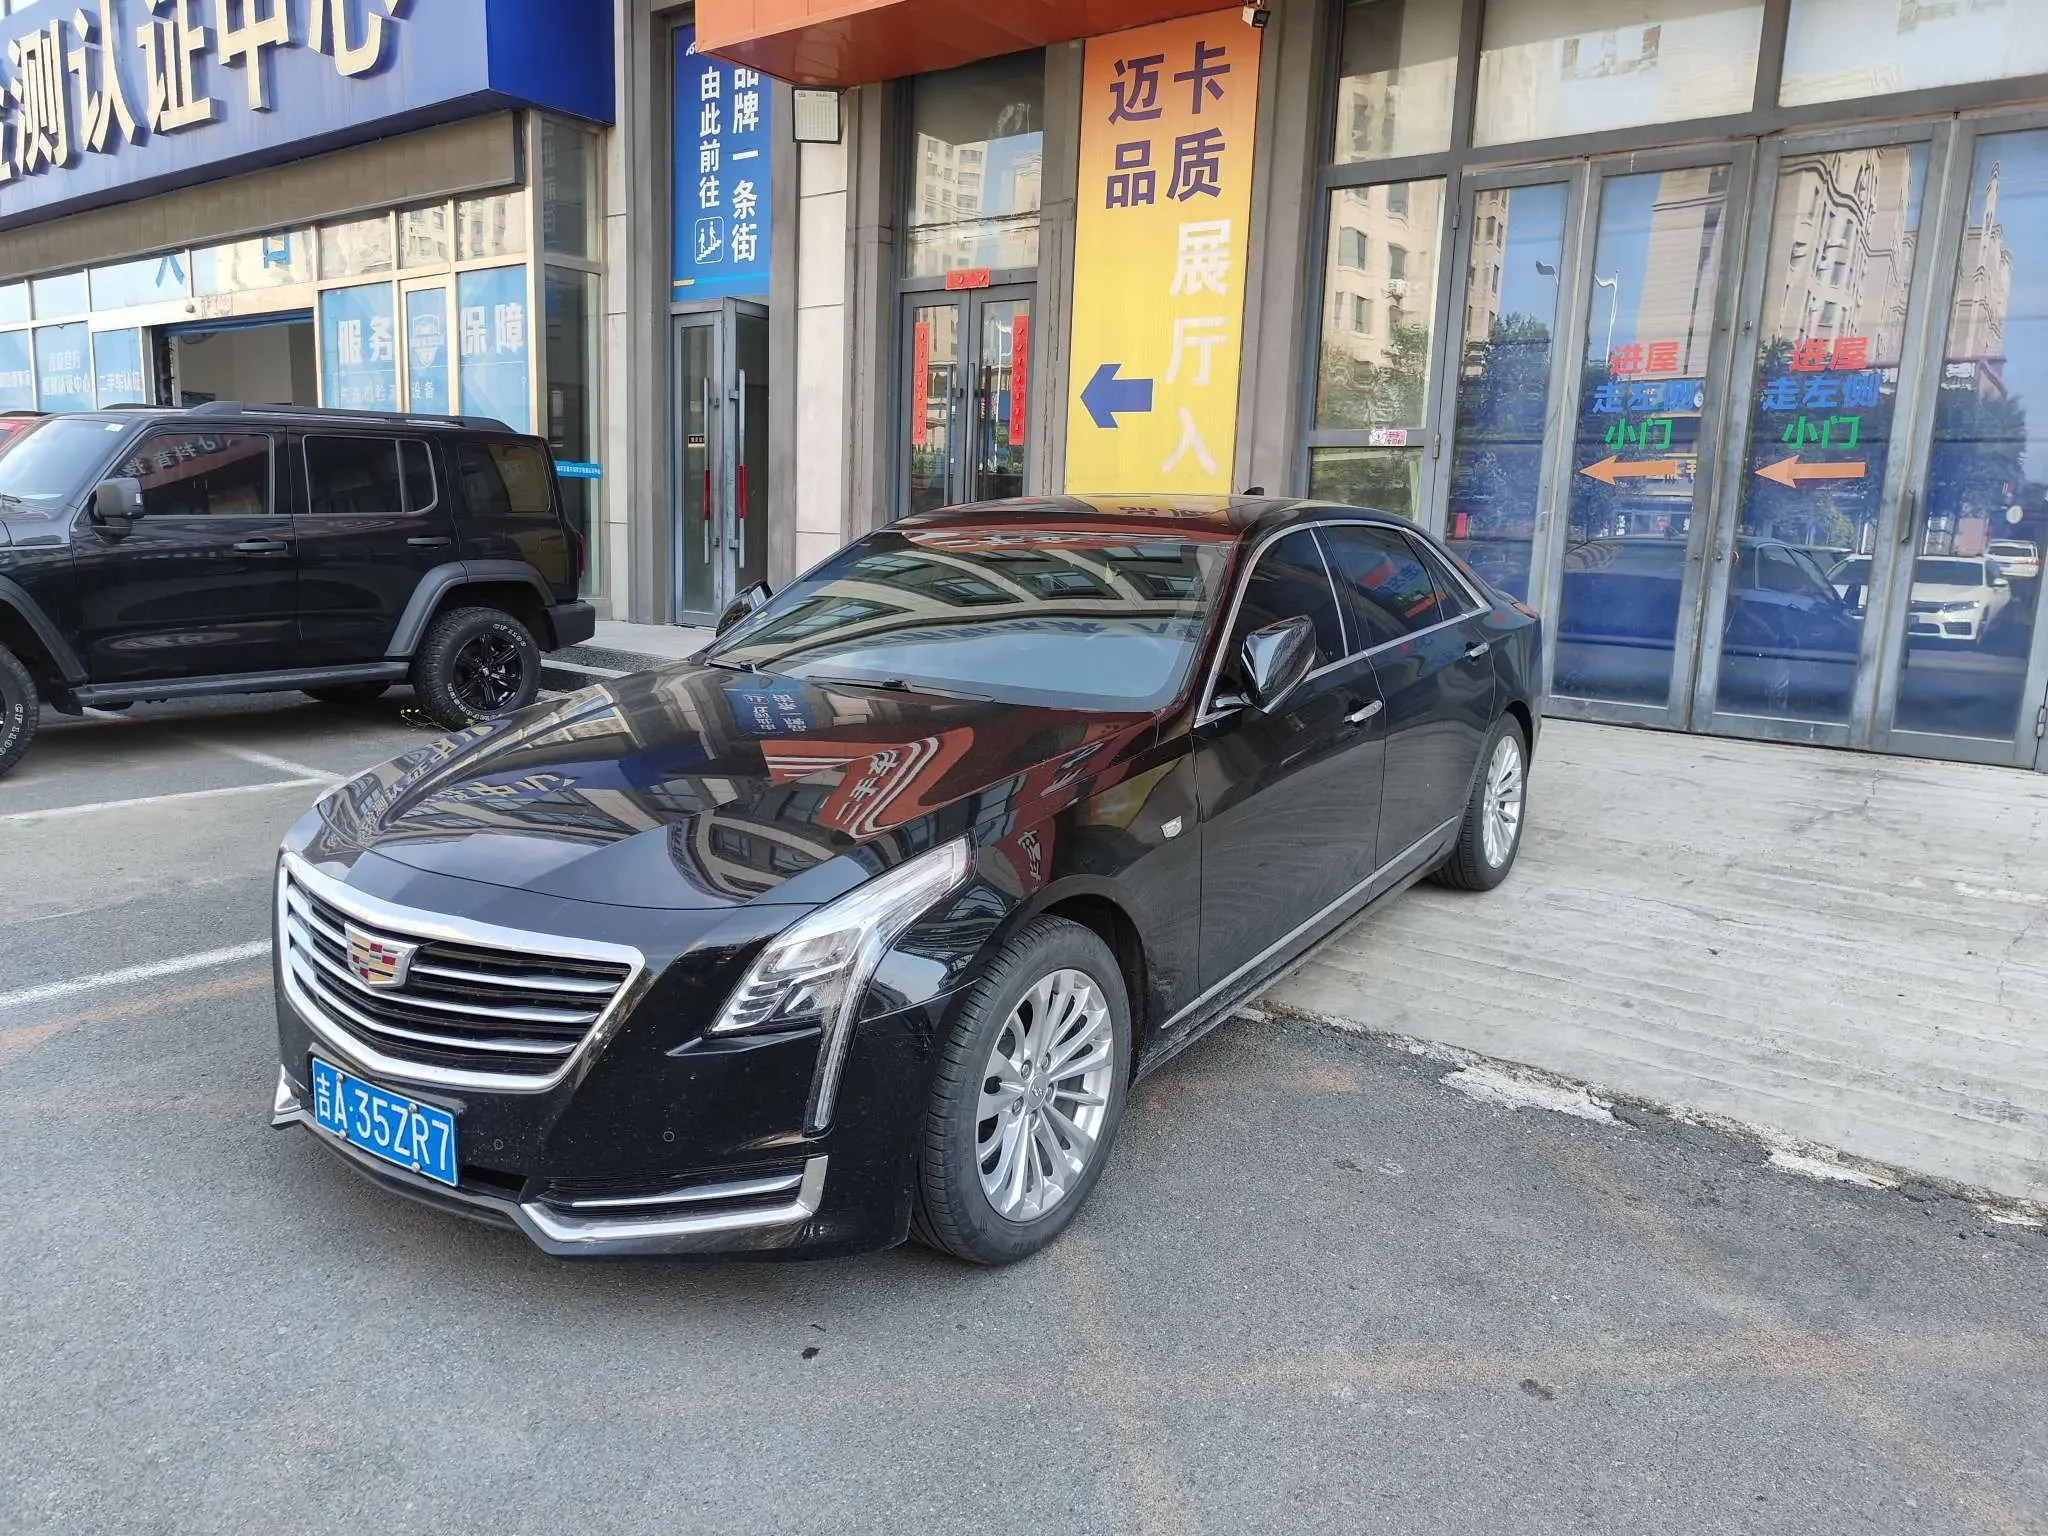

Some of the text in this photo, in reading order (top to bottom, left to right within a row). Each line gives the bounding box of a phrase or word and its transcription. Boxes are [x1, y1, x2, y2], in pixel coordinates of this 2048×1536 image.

[0, 0, 404, 182] 测认证中心
[1108, 41, 1231, 125] 迈卡
[699, 66, 721, 209] 由此前往
[1106, 127, 1226, 209] 品质
[1160, 219, 1232, 476] 展厅入
[1610, 341, 1680, 375] 进屋
[1789, 336, 1870, 372] 进屋
[1592, 380, 1696, 414] 走左侧
[1761, 374, 1882, 411] 走左侧
[1605, 417, 1673, 449] 小门
[1782, 415, 1861, 449] 小门
